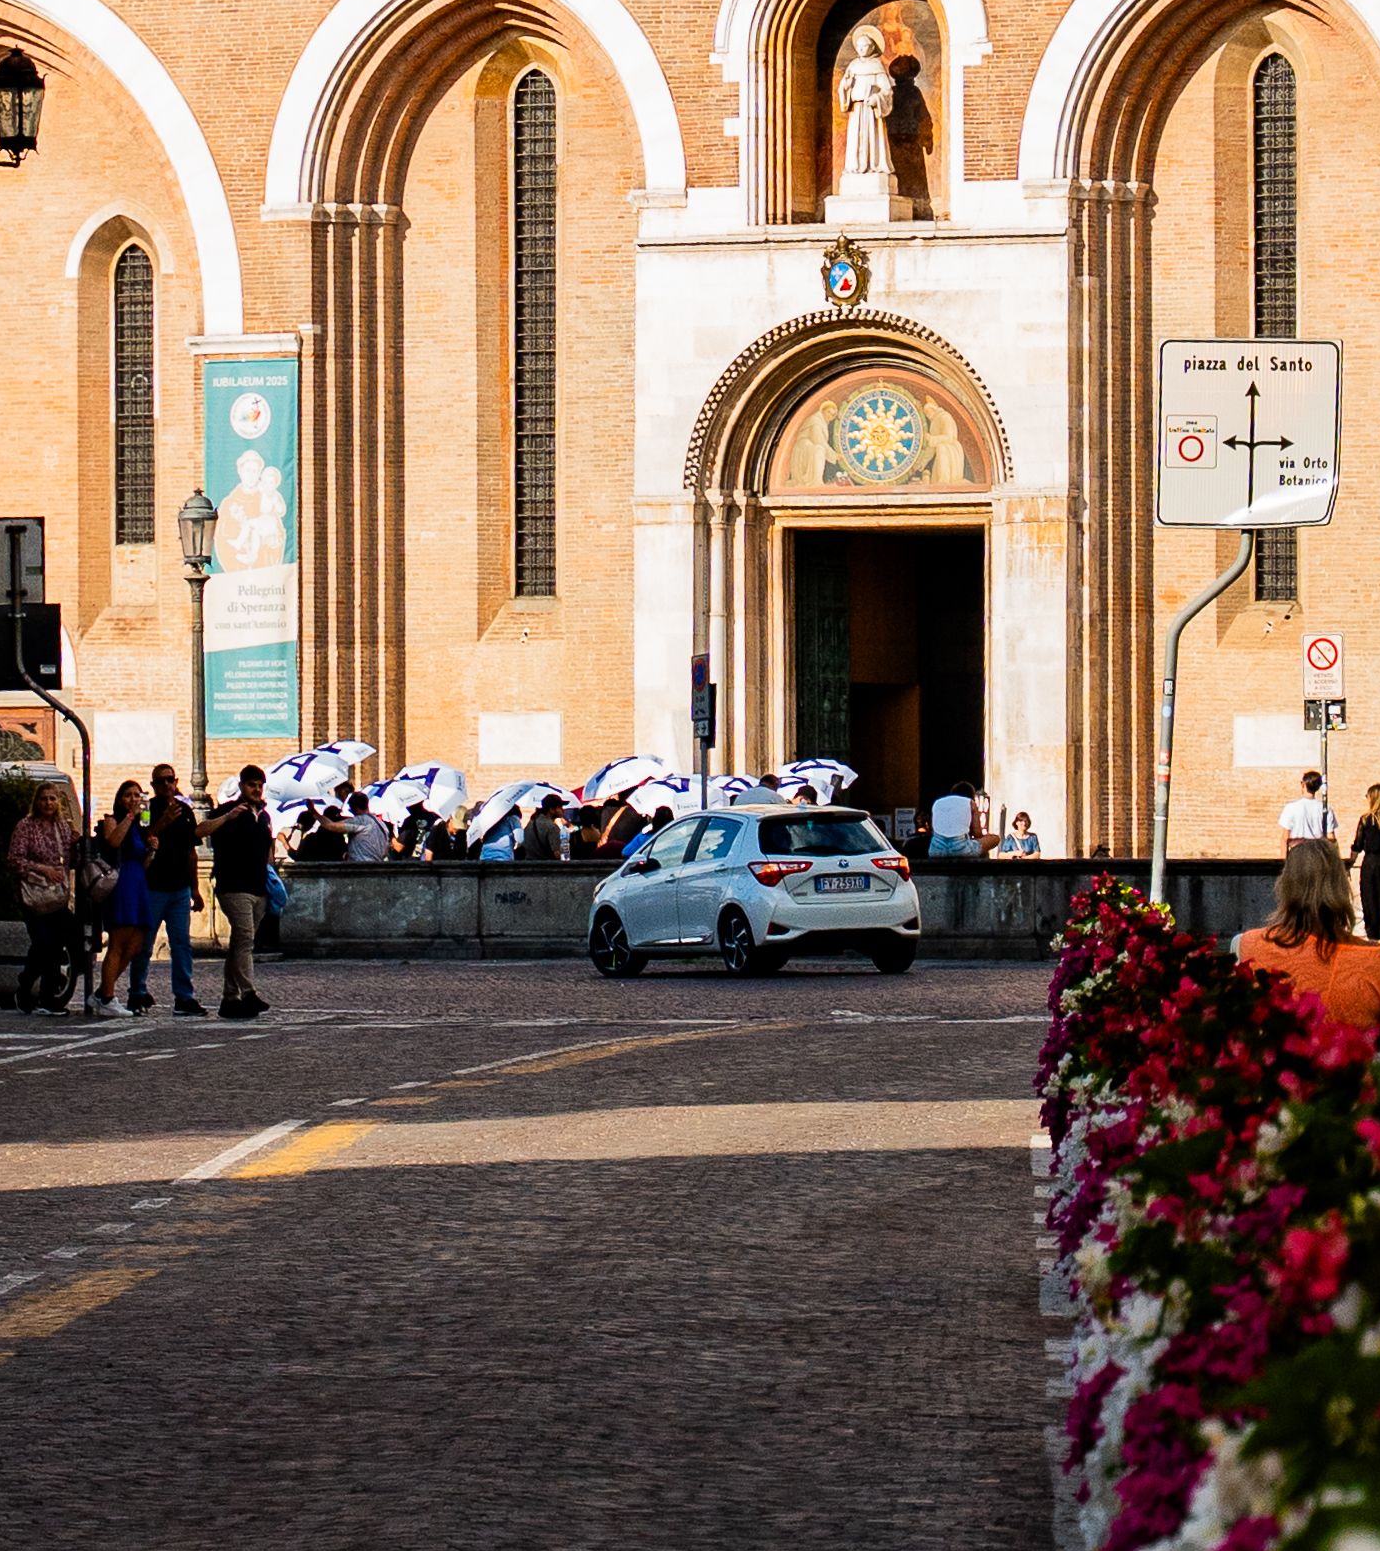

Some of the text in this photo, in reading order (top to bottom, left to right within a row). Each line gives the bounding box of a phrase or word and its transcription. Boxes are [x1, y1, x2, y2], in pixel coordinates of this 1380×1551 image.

[1184, 356, 1313, 374] piazza del Santo
[212, 376, 288, 387] IUBILAEUM 2025
[1279, 457, 1328, 469] via Orto
[238, 584, 286, 598] Pellegrini
[227, 602, 286, 616] di Speranza
